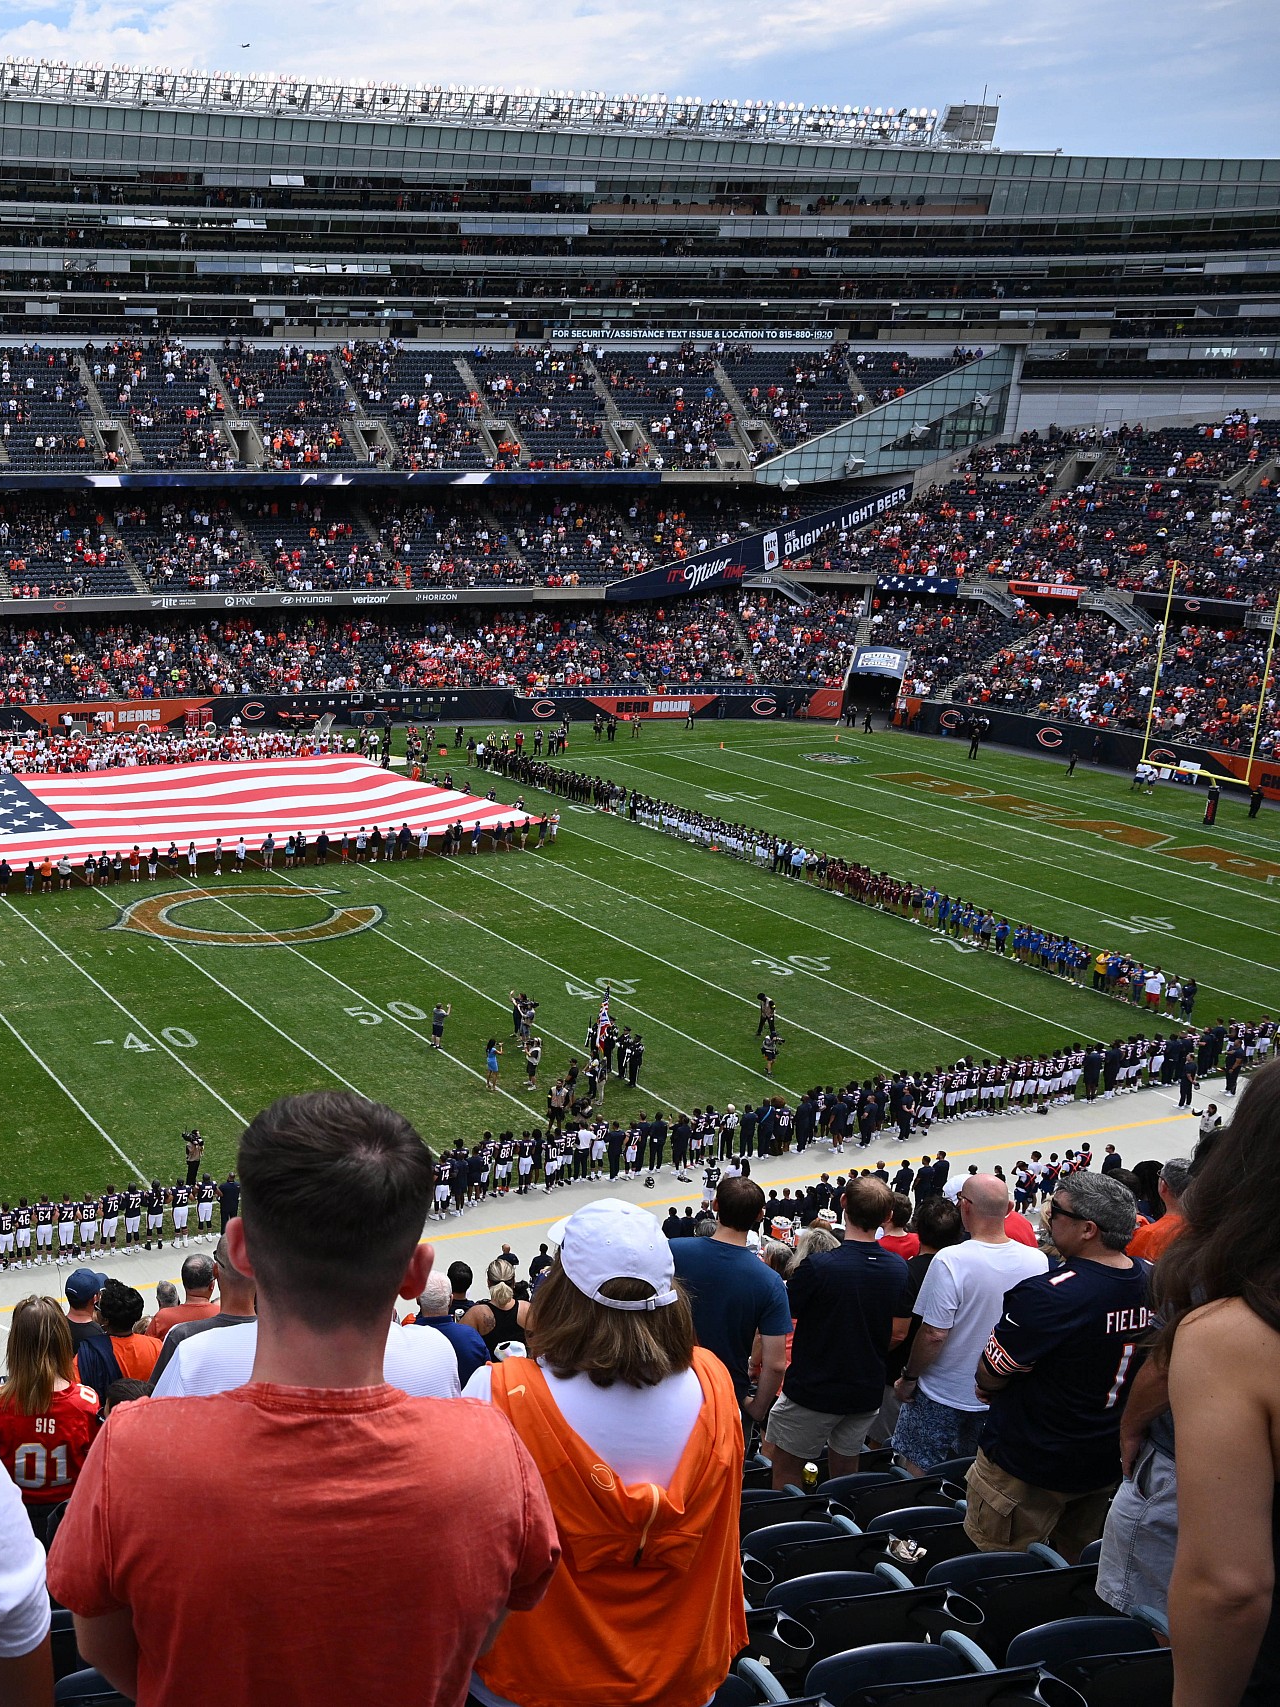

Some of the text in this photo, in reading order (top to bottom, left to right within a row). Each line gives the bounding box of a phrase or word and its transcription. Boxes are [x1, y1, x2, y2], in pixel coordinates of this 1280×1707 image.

[552, 330, 569, 338] FOR
[571, 330, 664, 338] SECURITY/ASSISTANCE
[666, 330, 687, 338] TEXT
[689, 330, 713, 338] ISSUE
[714, 330, 721, 338] &
[722, 330, 764, 338] LOCATION
[766, 330, 777, 338] TO
[841, 487, 906, 530] LIGHT BEER
[784, 529, 797, 539] THE
[667, 557, 746, 590] IT'S Miller TIME
[236, 597, 256, 606] PNC
[295, 595, 333, 603] HYUNDAI
[352, 595, 387, 604] verizon
[422, 593, 458, 601] HORIZON
[615, 700, 691, 713] BEAR DOWN
[118, 709, 161, 722] BEARS
[343, 1001, 428, 1025] 50
[123, 1026, 199, 1053] 40
[779, 1115, 789, 1127] 00
[596, 1128, 607, 1140] 87
[548, 1148, 557, 1159] 10
[441, 1169, 450, 1181] 14
[176, 1193, 188, 1205] 75
[201, 1189, 214, 1200] 70
[106, 1200, 119, 1212] 76
[129, 1197, 141, 1208] 72
[38, 1210, 51, 1221] 64
[60, 1211, 74, 1222] 74
[82, 1208, 95, 1219] 68
[19, 1214, 31, 1225] 46
[2, 1220, 12, 1231] 15
[1104, 1343, 1136, 1409] 1
[35, 1418, 56, 1435] SIS
[15, 1442, 72, 1489] 01
